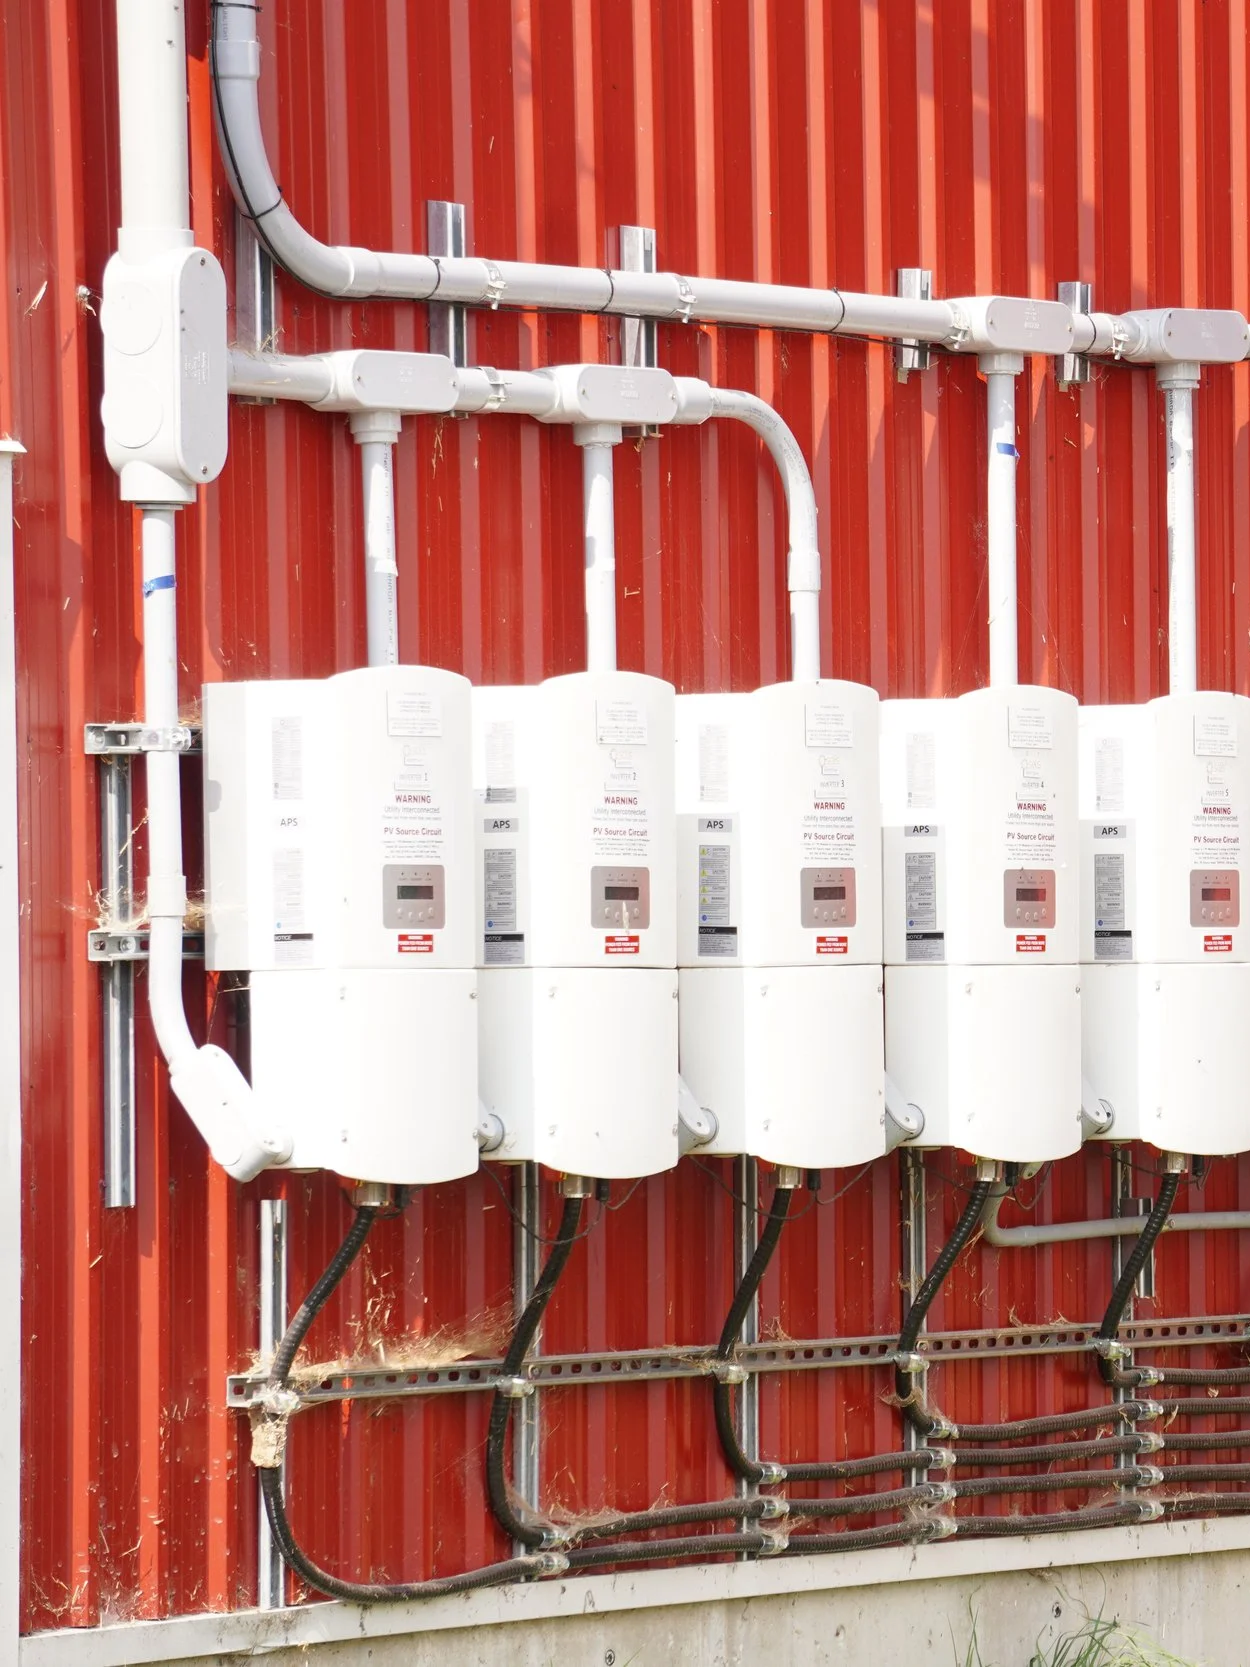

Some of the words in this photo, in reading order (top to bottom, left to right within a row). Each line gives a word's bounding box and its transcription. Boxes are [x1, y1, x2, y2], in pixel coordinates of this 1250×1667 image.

[632, 771, 637, 781] 2
[840, 779, 845, 788] 3
[1225, 788, 1229, 797] 5
[396, 795, 431, 804] WARNING
[604, 796, 638, 806] WARNING
[814, 802, 845, 810] WARNING
[1017, 803, 1046, 812] WARNING
[1203, 807, 1231, 815] WARNING
[280, 818, 298, 827] APS
[493, 820, 511, 829] APS
[706, 820, 724, 829] APS
[384, 827, 393, 835] PV
[396, 827, 420, 836] Source
[422, 828, 442, 836] Circuit
[593, 827, 603, 836] PV
[604, 828, 627, 836] Source
[629, 829, 648, 837] Circuit
[913, 825, 930, 833] APS
[1101, 827, 1118, 836] APS
[804, 832, 812, 840] PV
[814, 832, 835, 840] Source
[836, 832, 855, 841] Circuit
[1017, 832, 1036, 840] Source
[1038, 833, 1055, 841] Circuit
[1194, 835, 1201, 843] PV
